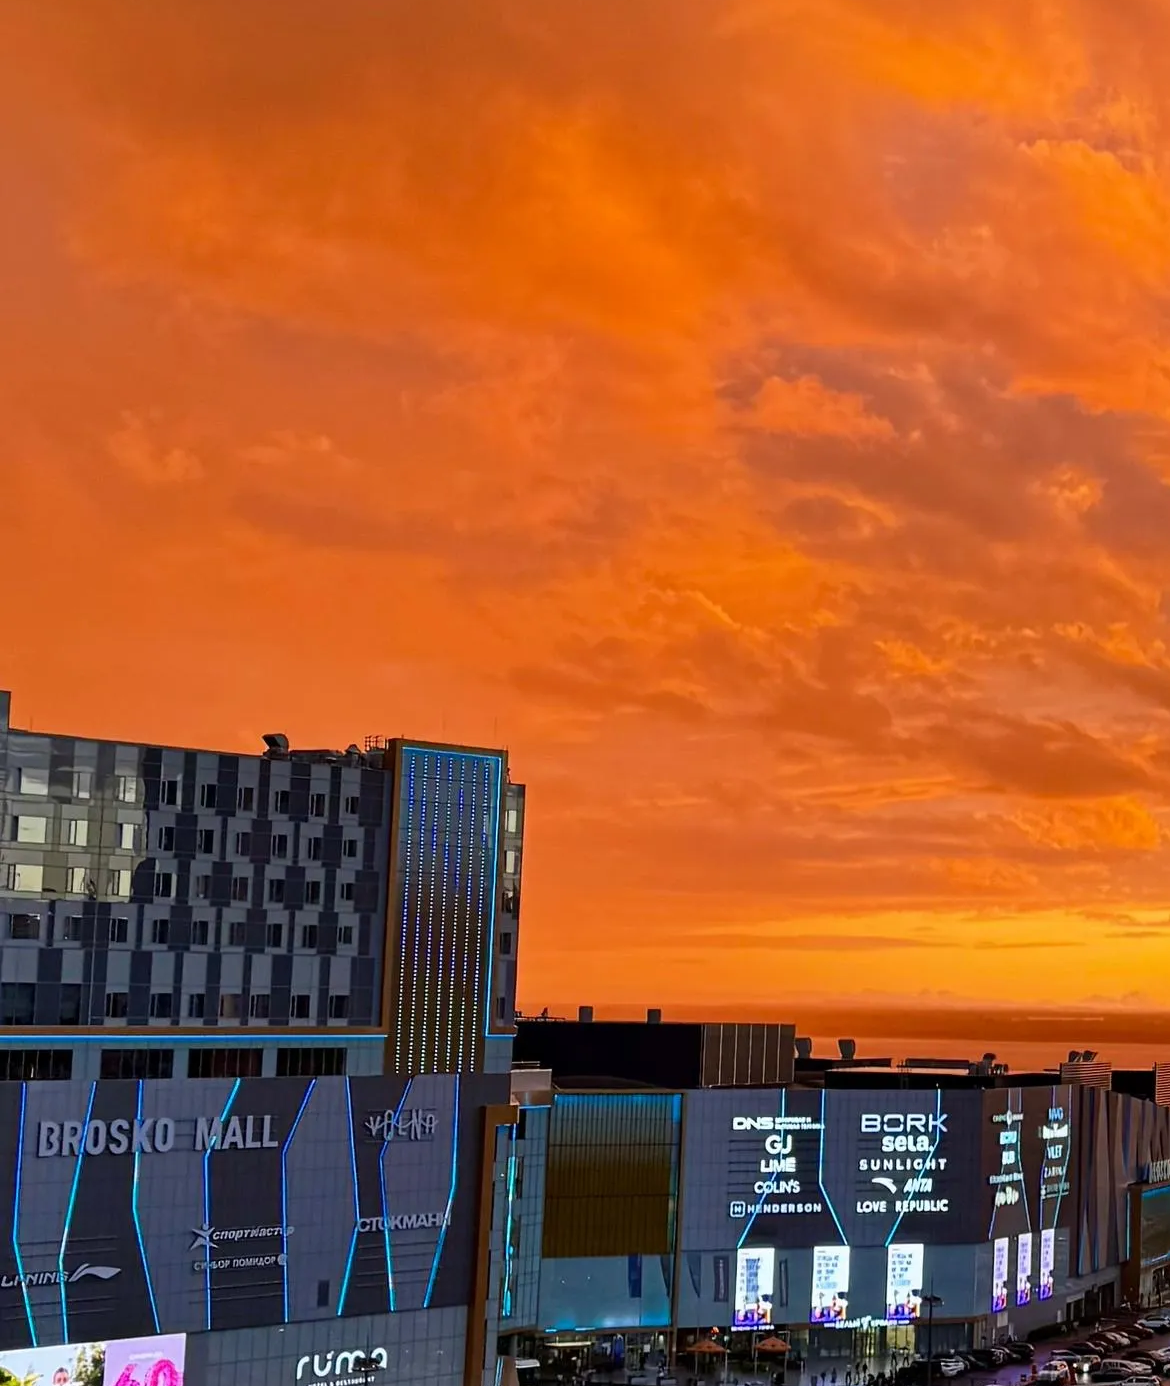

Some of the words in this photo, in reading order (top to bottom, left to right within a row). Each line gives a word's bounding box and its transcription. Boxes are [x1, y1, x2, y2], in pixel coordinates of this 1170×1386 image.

[732, 1116, 774, 1130] DNS
[861, 1113, 948, 1133] BORK
[36, 1116, 176, 1158] BROSKO
[194, 1114, 280, 1152] MALL
[764, 1134, 793, 1155] GJ
[760, 1157, 797, 1173] LIME
[859, 1158, 948, 1171] SUNLIGHT
[753, 1178, 801, 1194] COLIN'S
[747, 1202, 822, 1214] HENDERSON
[856, 1200, 887, 1213] LOVE
[895, 1198, 949, 1213] REPUBLIC
[212, 1225, 296, 1242] спортмастр
[233, 1255, 276, 1268] ПОМИДОР
[1, 1271, 69, 1287] LINING
